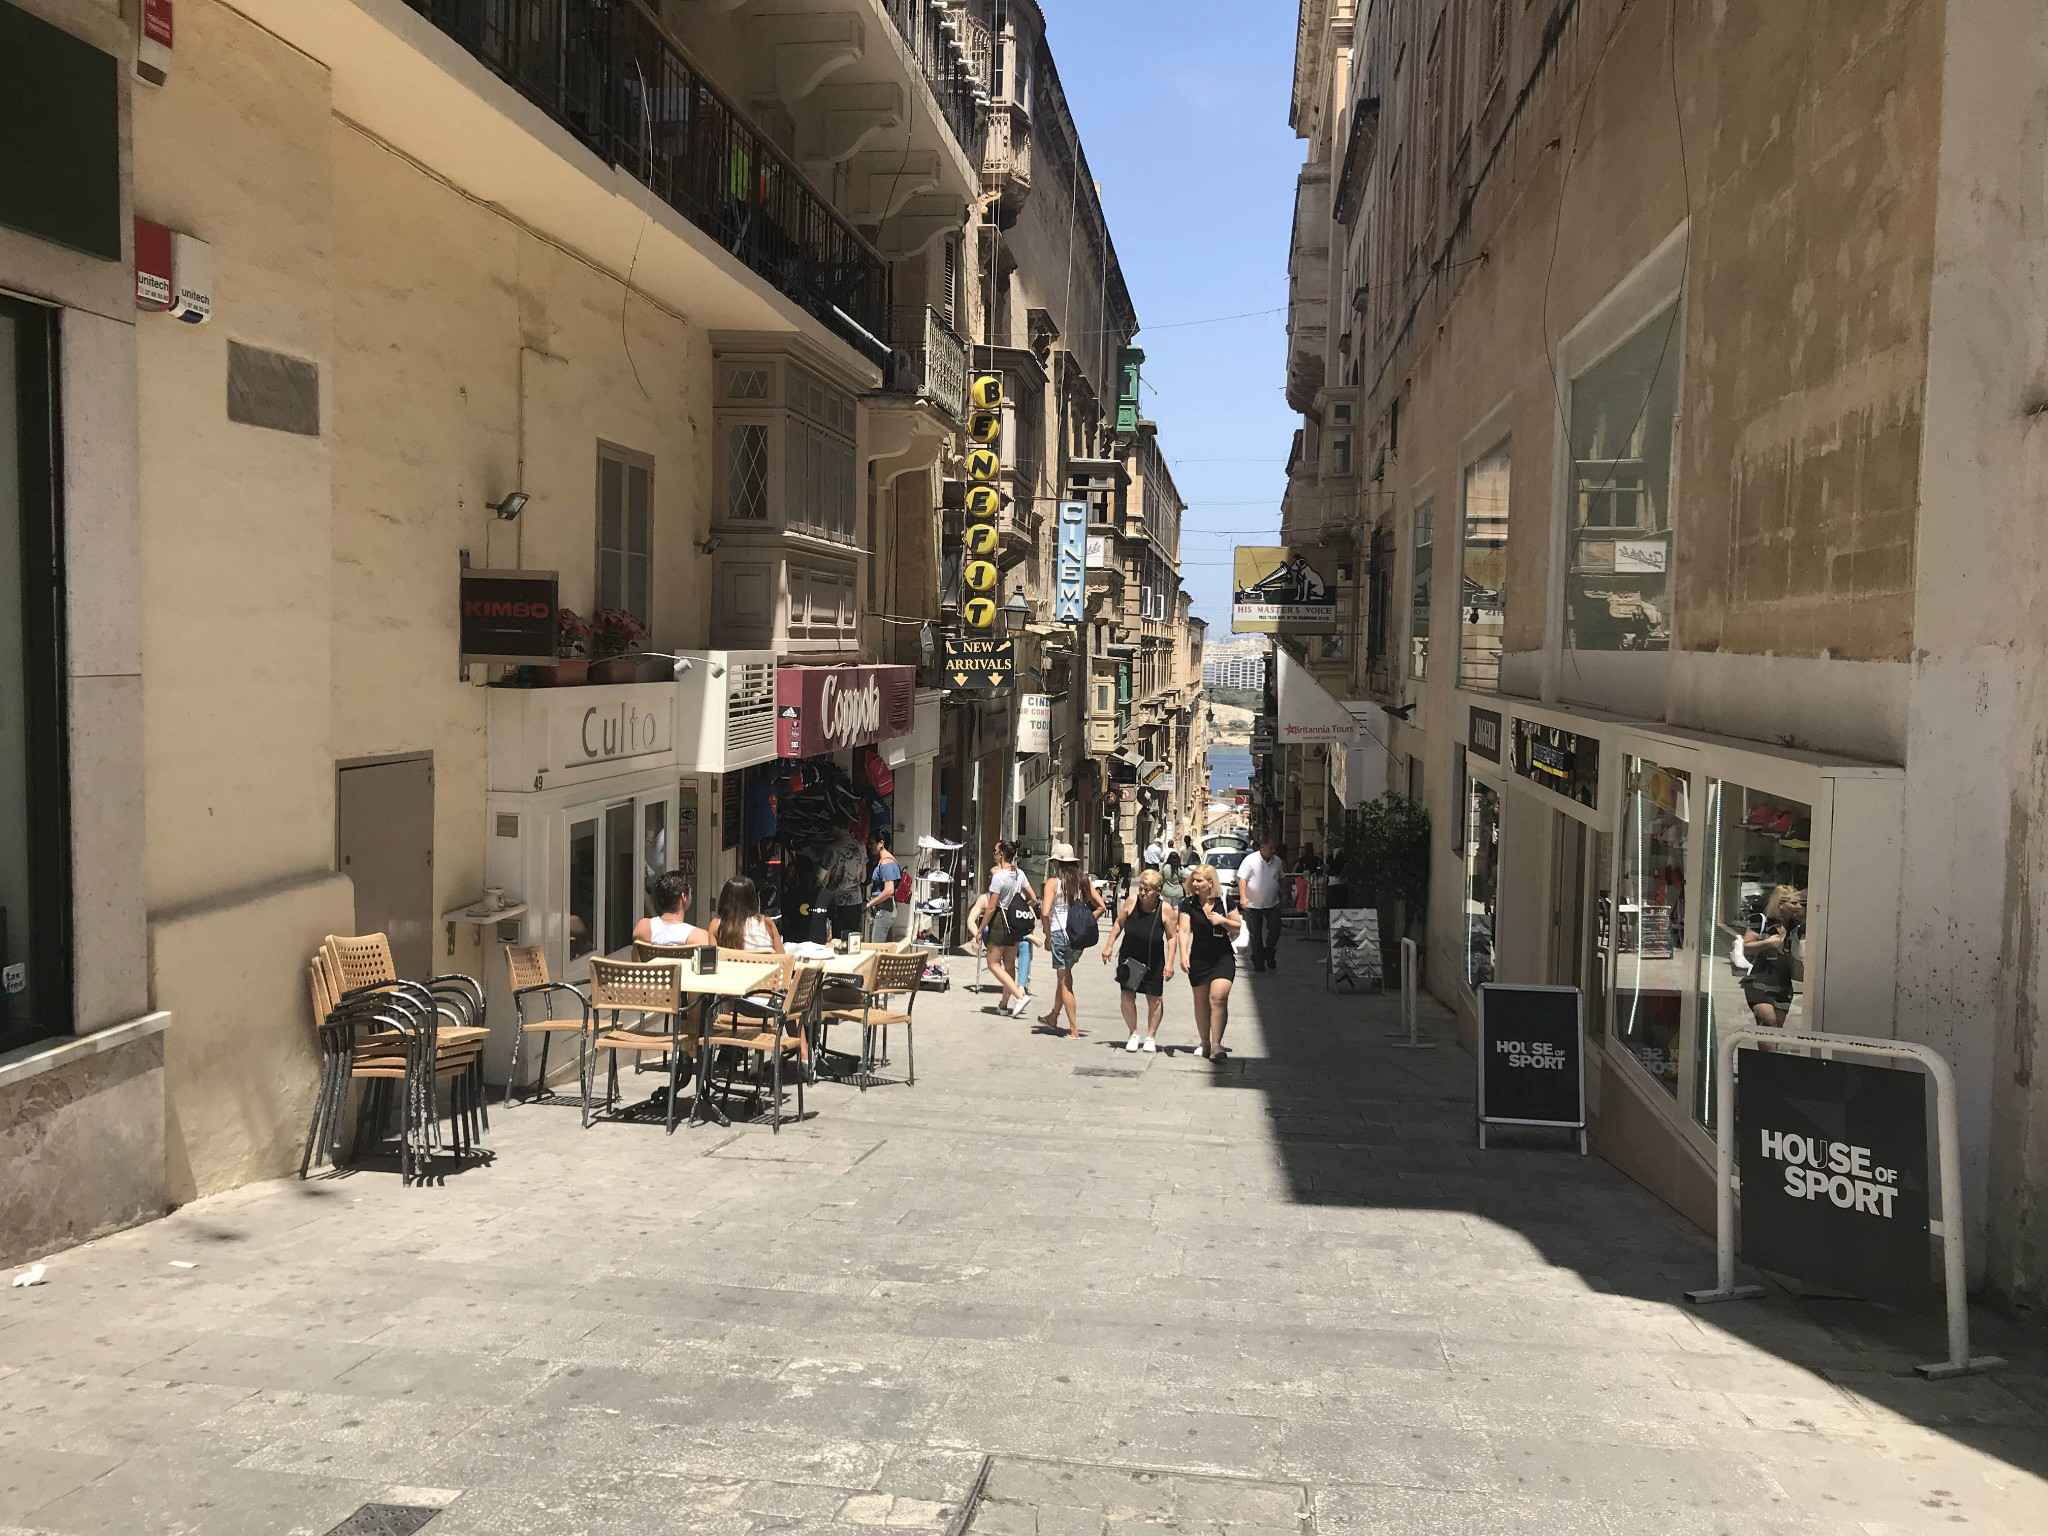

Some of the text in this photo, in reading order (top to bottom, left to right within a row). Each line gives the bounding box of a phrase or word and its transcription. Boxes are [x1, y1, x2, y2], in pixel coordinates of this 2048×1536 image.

[138, 275, 169, 291] unitech
[181, 289, 210, 304] unitech
[967, 381, 1000, 625] BENEFIT
[1060, 506, 1083, 620] CINEMA
[464, 602, 549, 618] KIMBO
[1237, 606, 1252, 614] HIS
[963, 641, 994, 653] NEW
[945, 658, 1012, 671] ARRIVALS
[821, 674, 880, 747] Coppola
[582, 701, 657, 758] Culto
[1295, 724, 1329, 735] Britannia
[533, 775, 544, 792] 49
[1555, 1049, 1566, 1057] OF
[1508, 1053, 1566, 1070] SPORT
[1761, 1128, 1898, 1184] HOUSE OF
[1783, 1165, 1899, 1219] SPORT
